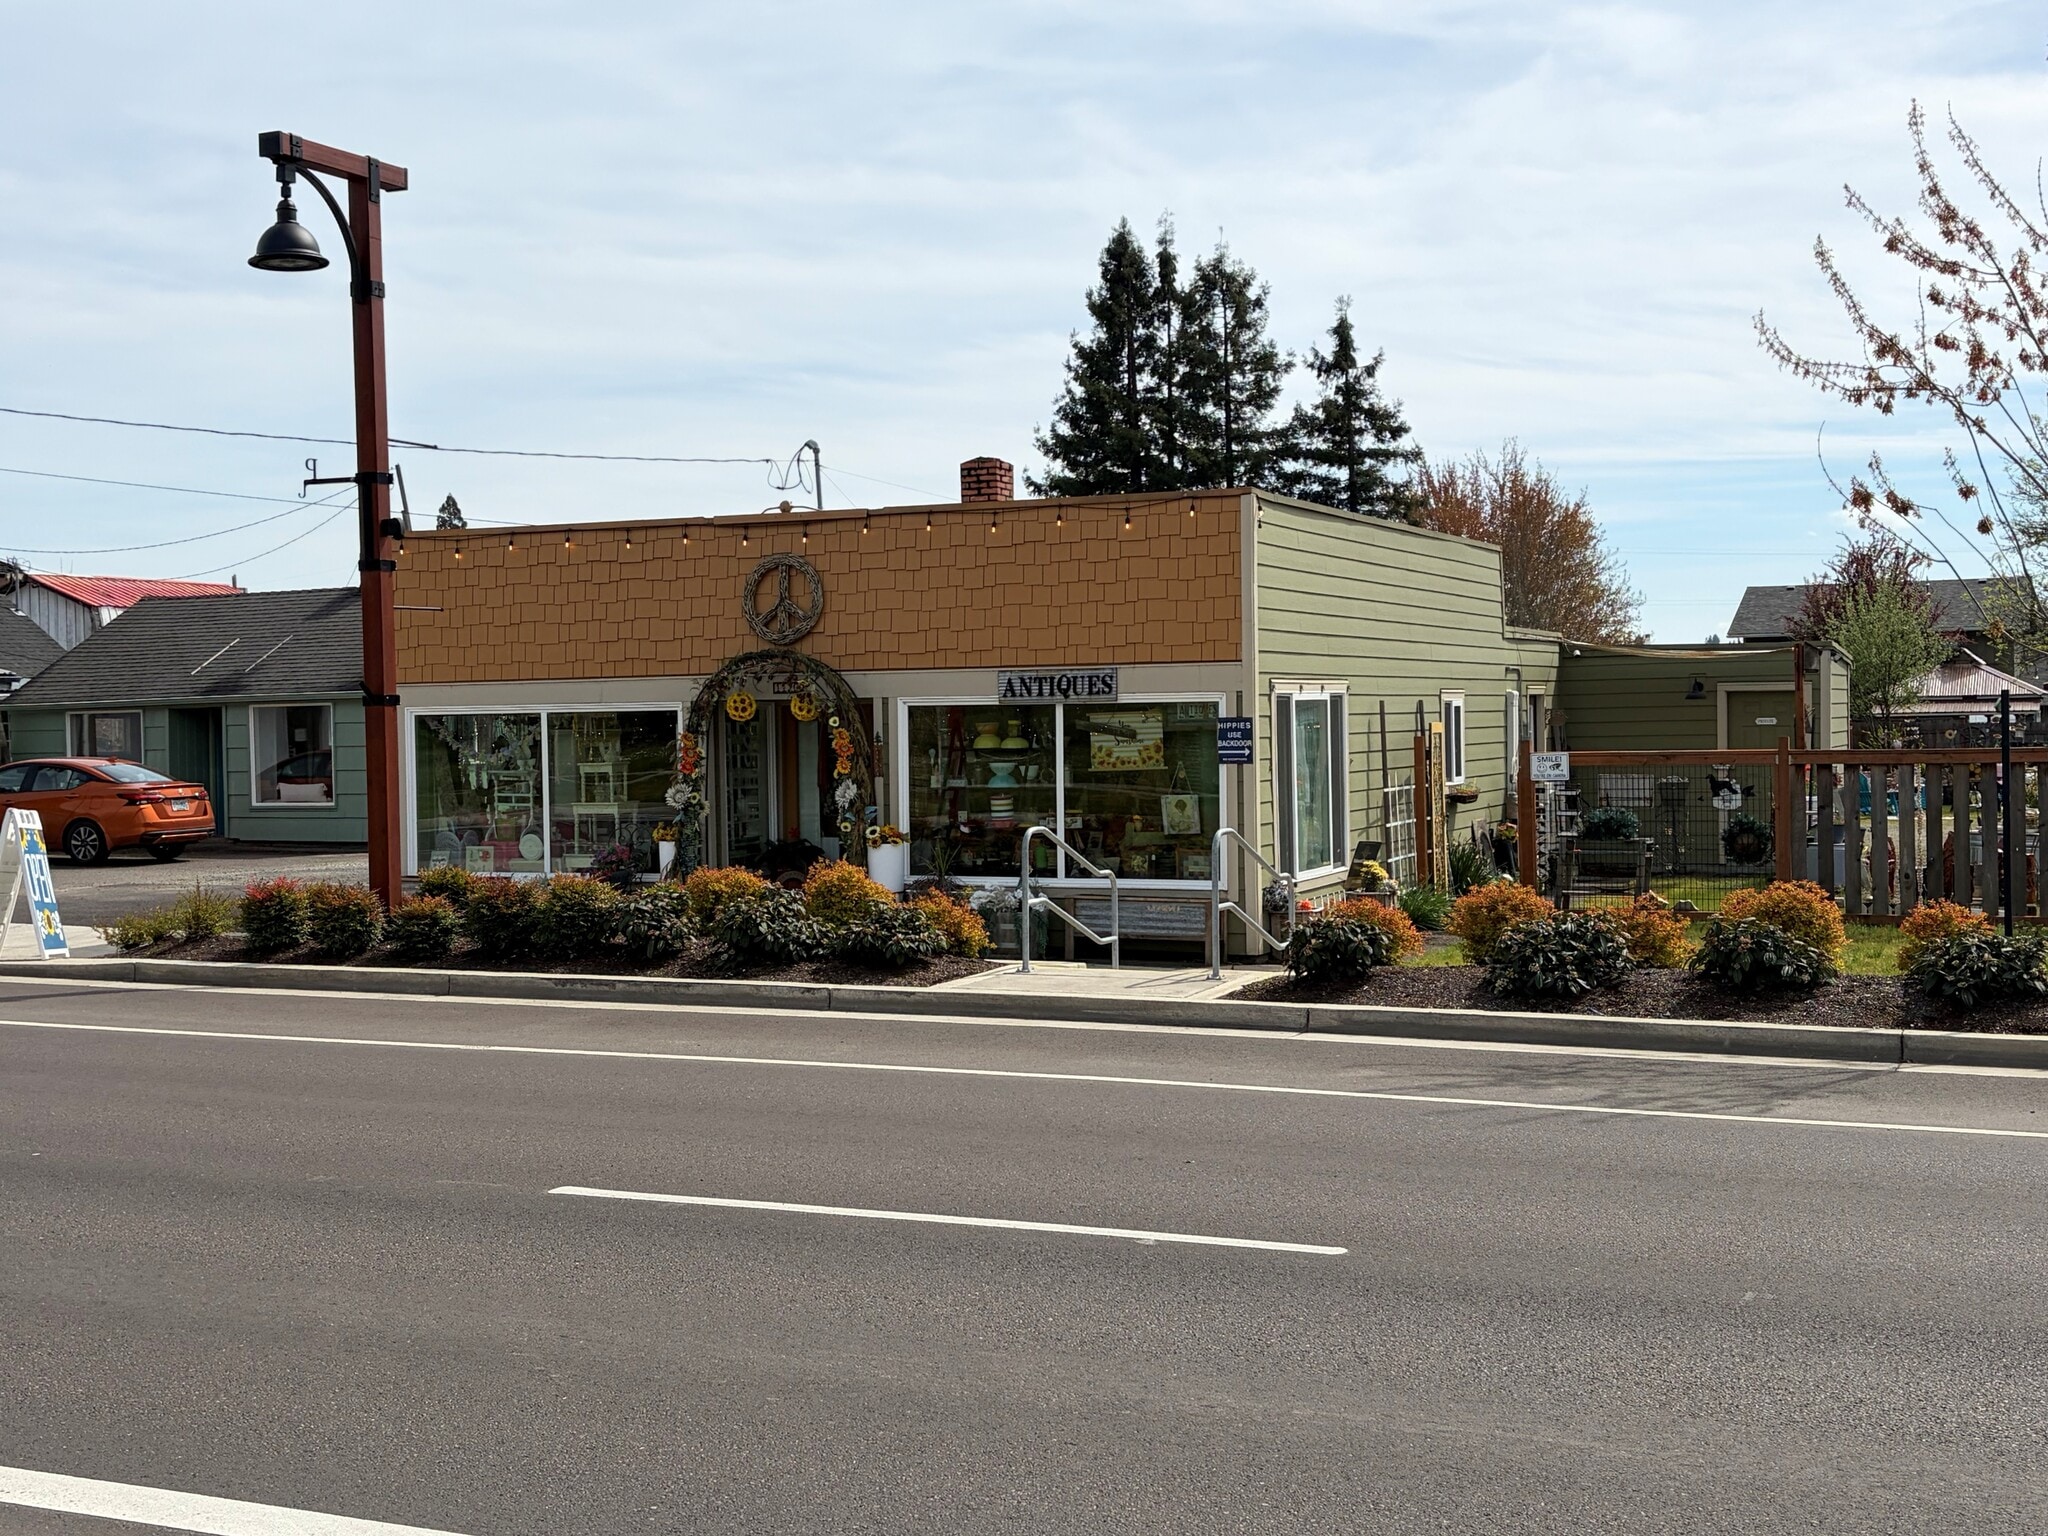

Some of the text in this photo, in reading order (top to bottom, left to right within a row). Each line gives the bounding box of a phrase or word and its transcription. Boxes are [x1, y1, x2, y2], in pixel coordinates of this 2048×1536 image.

[1002, 674, 1114, 699] ANTIQUES
[1536, 755, 1562, 763] SMILE!
[25, 853, 57, 904] OPEN
